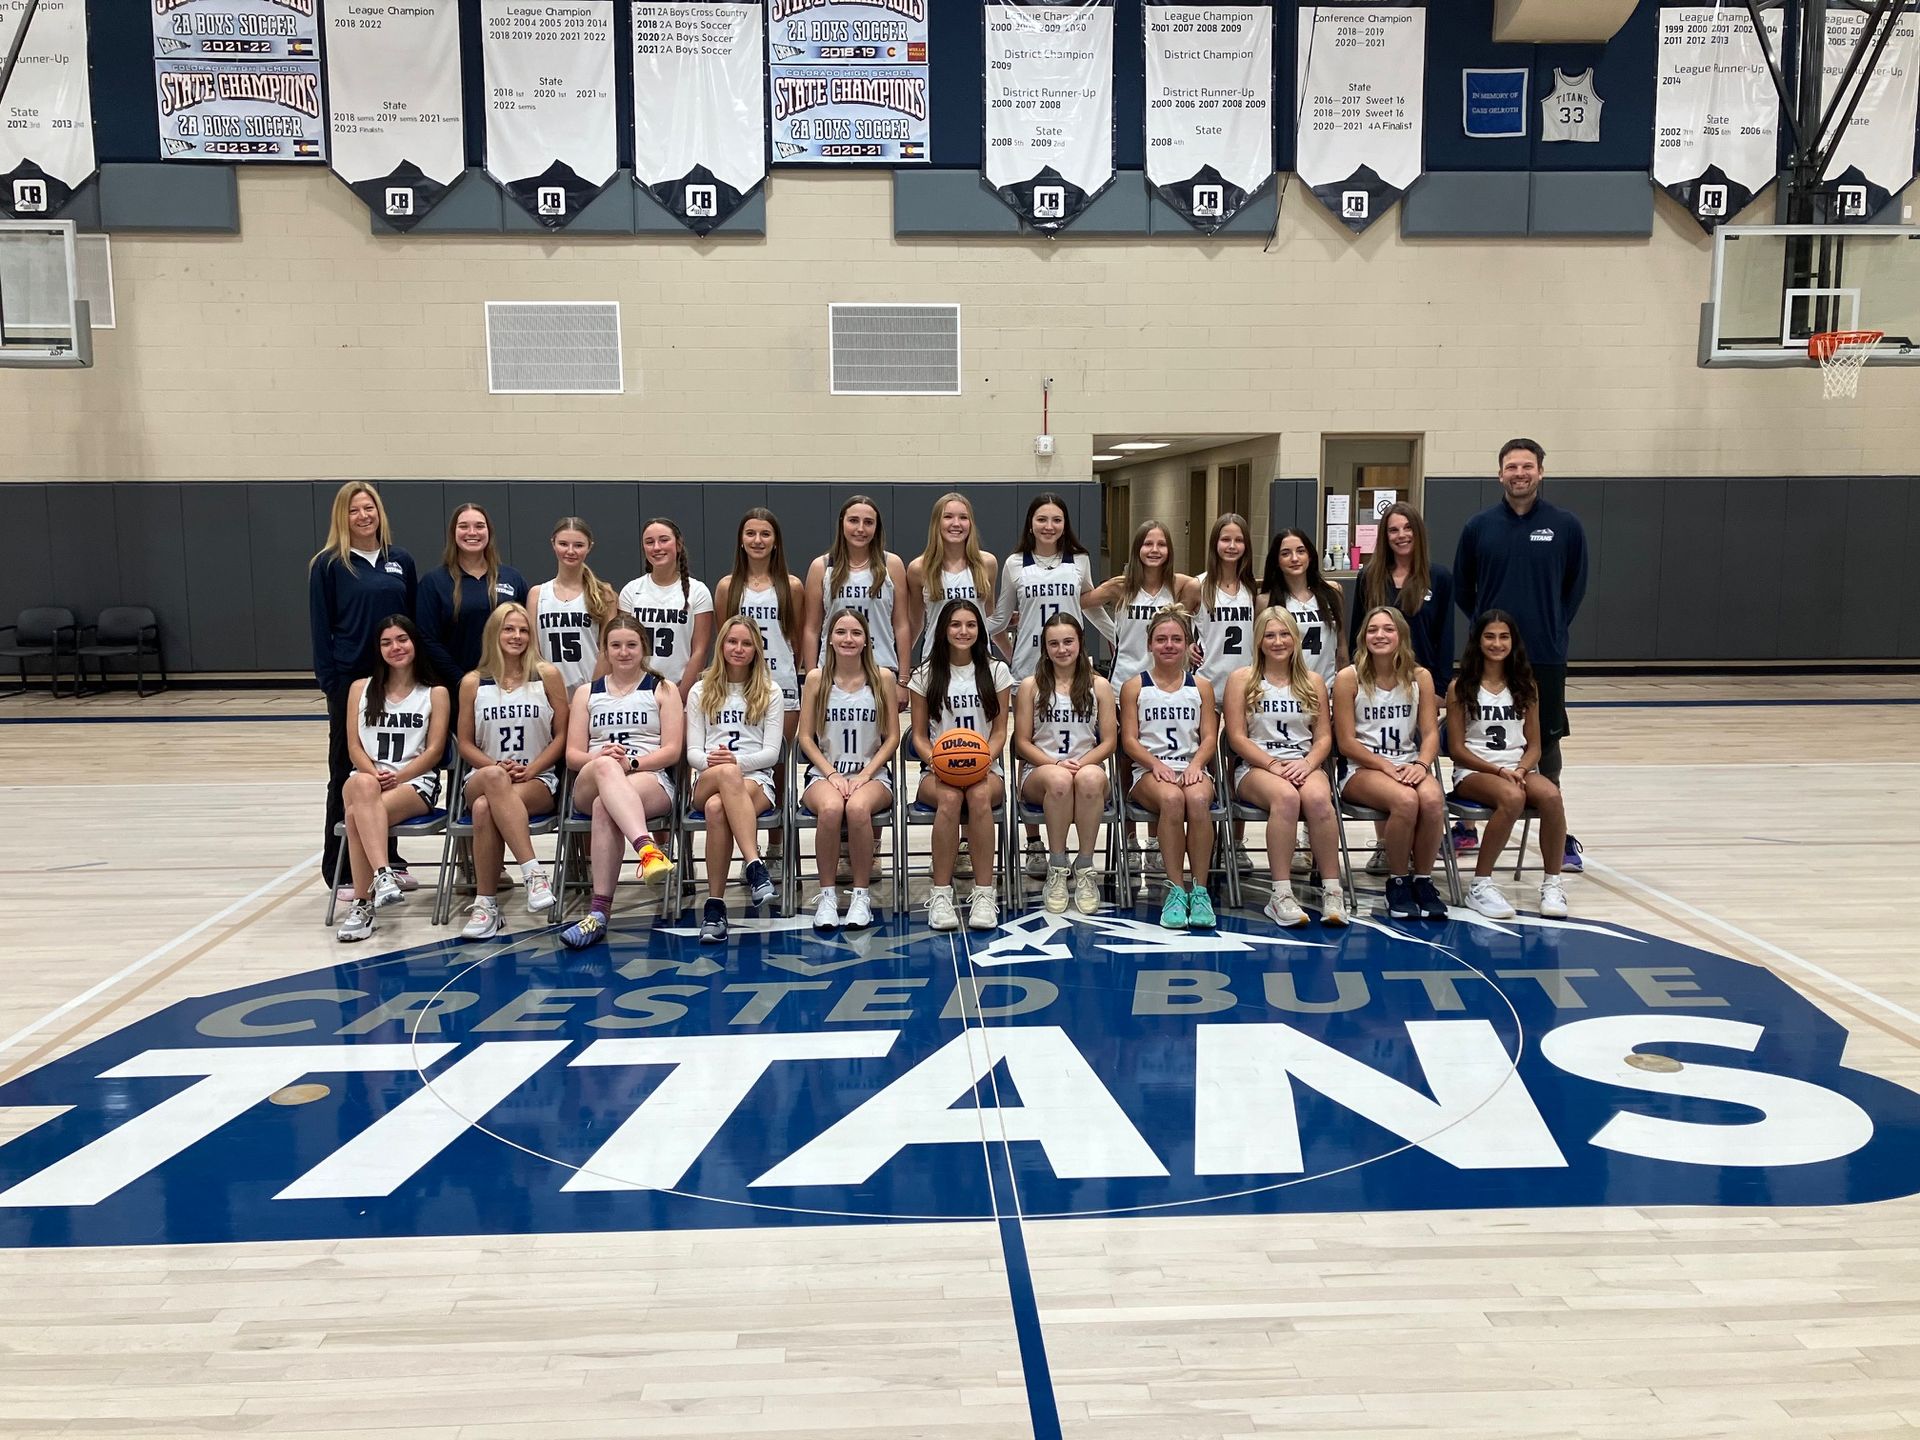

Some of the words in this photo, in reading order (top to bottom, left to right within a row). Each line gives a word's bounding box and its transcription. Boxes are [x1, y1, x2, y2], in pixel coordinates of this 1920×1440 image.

[12, 1, 64, 11] Chpion
[348, 6, 384, 16] League
[388, 6, 434, 16] Champion
[507, 6, 542, 17] League
[545, 6, 592, 17] Champion
[637, 8, 656, 17] 2011
[658, 8, 669, 17] 2A
[670, 8, 690, 18] Boys
[691, 8, 714, 17] Cross
[715, 8, 748, 20] Country
[1164, 12, 1200, 22] League
[1204, 12, 1254, 22] Champion
[1314, 14, 1365, 24] Conference
[1368, 14, 1412, 24] Champion
[1680, 13, 1714, 24] League
[172, 14, 192, 35] 2A
[195, 14, 233, 35] BOYS
[238, 14, 297, 36] SOCCER
[335, 19, 356, 28] 2018
[360, 19, 382, 28] 2022
[489, 18, 511, 27] 2002
[514, 18, 536, 27] 2004
[540, 18, 562, 27] 2005
[564, 18, 584, 27] 2013
[587, 18, 608, 27] 2014
[637, 20, 658, 30] 2018
[660, 20, 672, 30] 2A
[675, 20, 698, 31] Boys
[700, 21, 732, 30] Soccer
[788, 21, 806, 41] 2A
[811, 21, 848, 41] BOYS
[853, 21, 908, 41] SOCCER
[637, 33, 660, 42] 2020
[660, 33, 674, 42] 2A
[677, 34, 698, 44] Boys
[700, 34, 734, 43] Soccer
[202, 41, 271, 52] 2021-22
[637, 46, 658, 54] 2021
[660, 46, 673, 54] 2A
[676, 46, 698, 57] Boys
[701, 46, 732, 56] Soccer
[820, 48, 876, 57] 2018-19
[1004, 50, 1042, 59] District
[1044, 50, 1094, 61] Champion
[1164, 50, 1200, 60] District
[1204, 50, 1254, 60] Champion
[991, 61, 1012, 70] 2009
[1674, 64, 1711, 75] League
[1713, 64, 1764, 74] Runner-Up
[786, 69, 840, 77] COLORADO
[843, 69, 868, 77] HIGH
[872, 69, 913, 77] SCHOOL
[539, 77, 564, 86] State
[1662, 77, 1681, 85] 2014
[1163, 88, 1199, 97] District
[1202, 88, 1254, 98] Runner-Up
[1348, 83, 1372, 92] State
[161, 73, 217, 118] STATE
[219, 73, 320, 118] CHAMPIONS
[494, 90, 514, 98] 2018
[534, 90, 556, 98] 2020
[576, 90, 596, 98] 2021
[774, 77, 828, 120] STATE
[830, 77, 926, 120] CHAMPIONS
[1003, 88, 1038, 98] District
[1042, 88, 1096, 99] Runner-Up
[1556, 94, 1588, 104] TITANS
[383, 101, 407, 110] State
[992, 100, 1012, 108] 2000
[1016, 101, 1036, 110] 2007
[1040, 101, 1060, 110] 2008
[1366, 96, 1394, 104] Sweet
[1396, 96, 1405, 104] 16
[494, 102, 516, 110] 2022
[11, 108, 39, 117] State
[1366, 109, 1394, 118] Sweet
[1396, 109, 1404, 118] 16
[1560, 108, 1584, 123] 33
[8, 120, 28, 128] 2012
[52, 120, 72, 128] 2013
[1706, 115, 1729, 124] State
[1850, 118, 1870, 126] tate
[178, 116, 198, 138] 2A
[204, 116, 240, 138] BOYS
[245, 116, 305, 138] SOCCER
[334, 124, 357, 133] 2023
[790, 120, 810, 140] 2A
[814, 120, 851, 140] BOYS
[854, 120, 911, 140] SOCCER
[1036, 127, 1062, 136] State
[1195, 126, 1222, 135] State
[1368, 122, 1381, 131] 4A
[1382, 122, 1412, 131] Finalist
[204, 143, 280, 153] 2023-24
[992, 138, 1012, 148] 2008
[1031, 138, 1052, 148] 2009
[1151, 138, 1172, 147] 2008
[822, 146, 882, 156] 2020-21
[1025, 583, 1075, 599] CRESTED
[539, 612, 592, 630] TITANS
[634, 608, 688, 624] TITANS
[1223, 626, 1242, 654] 2
[1302, 627, 1322, 655] 4
[548, 632, 582, 662] 15
[483, 704, 540, 721] CRESTED
[825, 708, 876, 722] CRESTED
[1145, 708, 1196, 722] CRESTED
[592, 711, 648, 728] CRESTED
[1276, 720, 1290, 741] 4
[499, 726, 524, 752] 23
[728, 730, 740, 752] 2
[842, 728, 857, 754] 11
[1058, 730, 1070, 754] 3
[1166, 728, 1178, 751] 5
[1380, 726, 1400, 750] 14
[1485, 726, 1506, 750] 3
[377, 732, 406, 763] 11
[942, 738, 980, 751] Wilson
[948, 758, 976, 769] NCAA
[1131, 967, 1730, 1016] BUTTE
[195, 976, 1059, 1039] CRESTED
[0, 1014, 1875, 1206] TITANS
